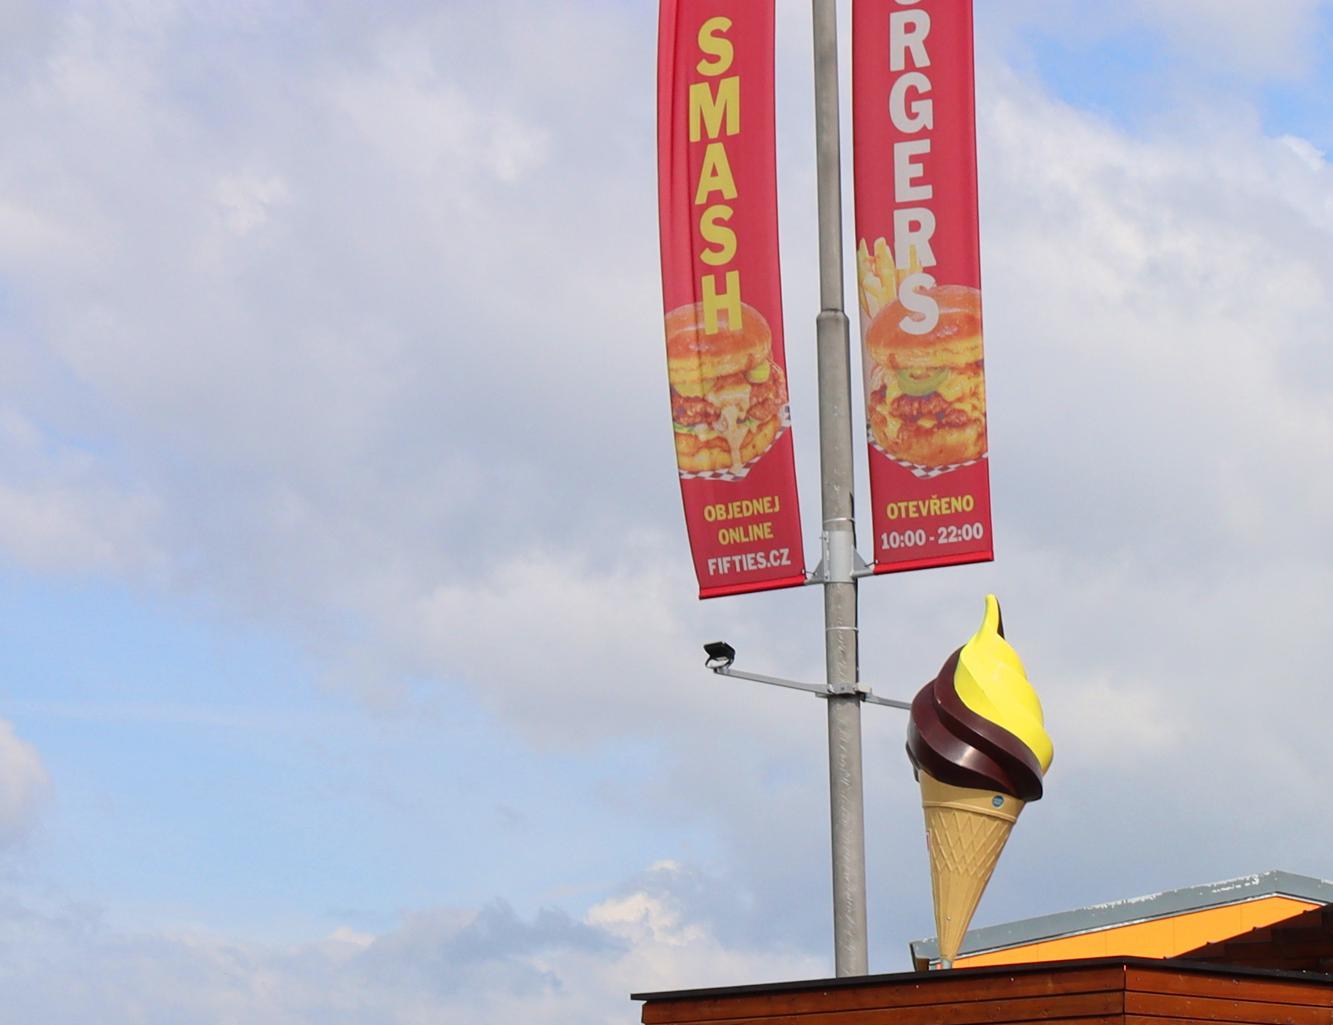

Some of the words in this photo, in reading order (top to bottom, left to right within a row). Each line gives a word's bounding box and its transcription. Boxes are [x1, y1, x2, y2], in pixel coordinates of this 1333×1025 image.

[688, 16, 743, 335] SMASH
[889, 0, 940, 335] RGERS
[703, 496, 780, 522] OBJEDNEJ
[886, 494, 975, 520] OTEVŘENO
[718, 522, 774, 545] ONLINE
[881, 531, 926, 549] 10:00
[938, 523, 984, 544] 22:00
[707, 548, 791, 575] FIFTIES.CZ
